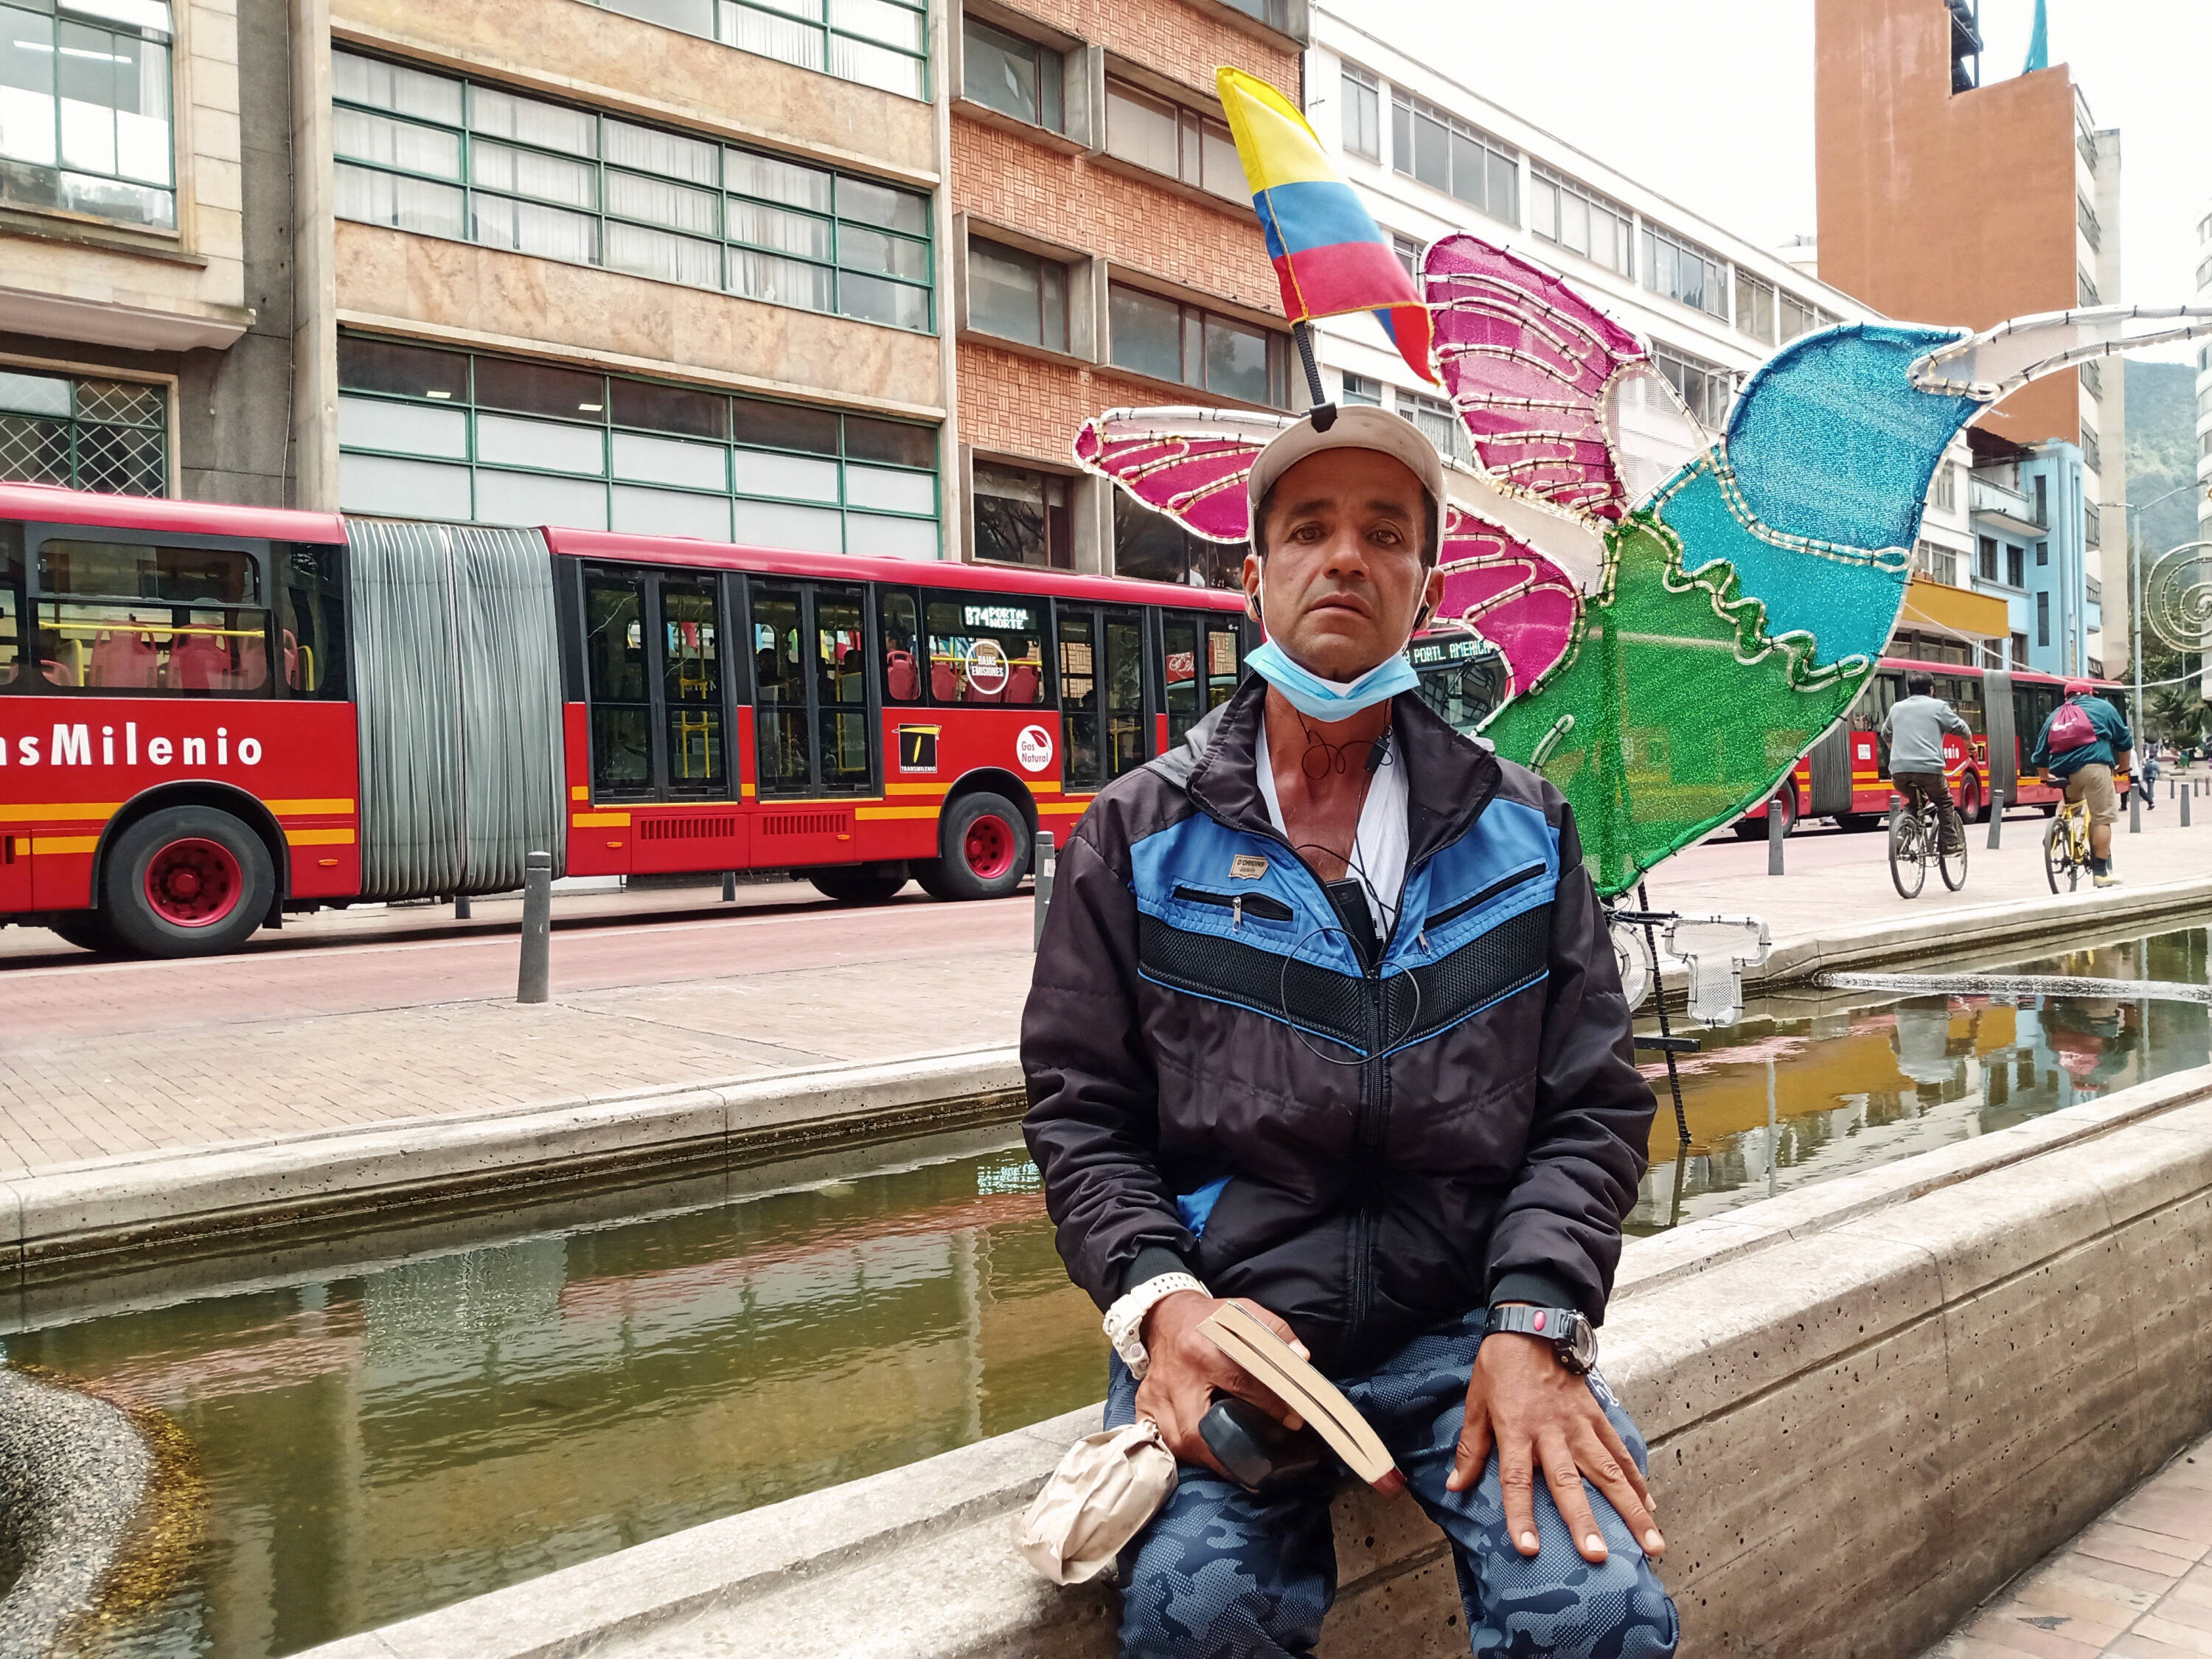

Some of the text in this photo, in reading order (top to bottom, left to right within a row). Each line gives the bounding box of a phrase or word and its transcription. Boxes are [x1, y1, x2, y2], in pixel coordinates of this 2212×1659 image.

[989, 607, 1029, 620] PORTAL
[990, 618, 1025, 630] NORTE
[978, 655, 996, 665] BAJAS
[1413, 645, 1446, 664] PORTL.
[971, 666, 1004, 677] EMISIONES
[1021, 741, 1035, 751] Gas
[1021, 753, 1048, 762] Natural
